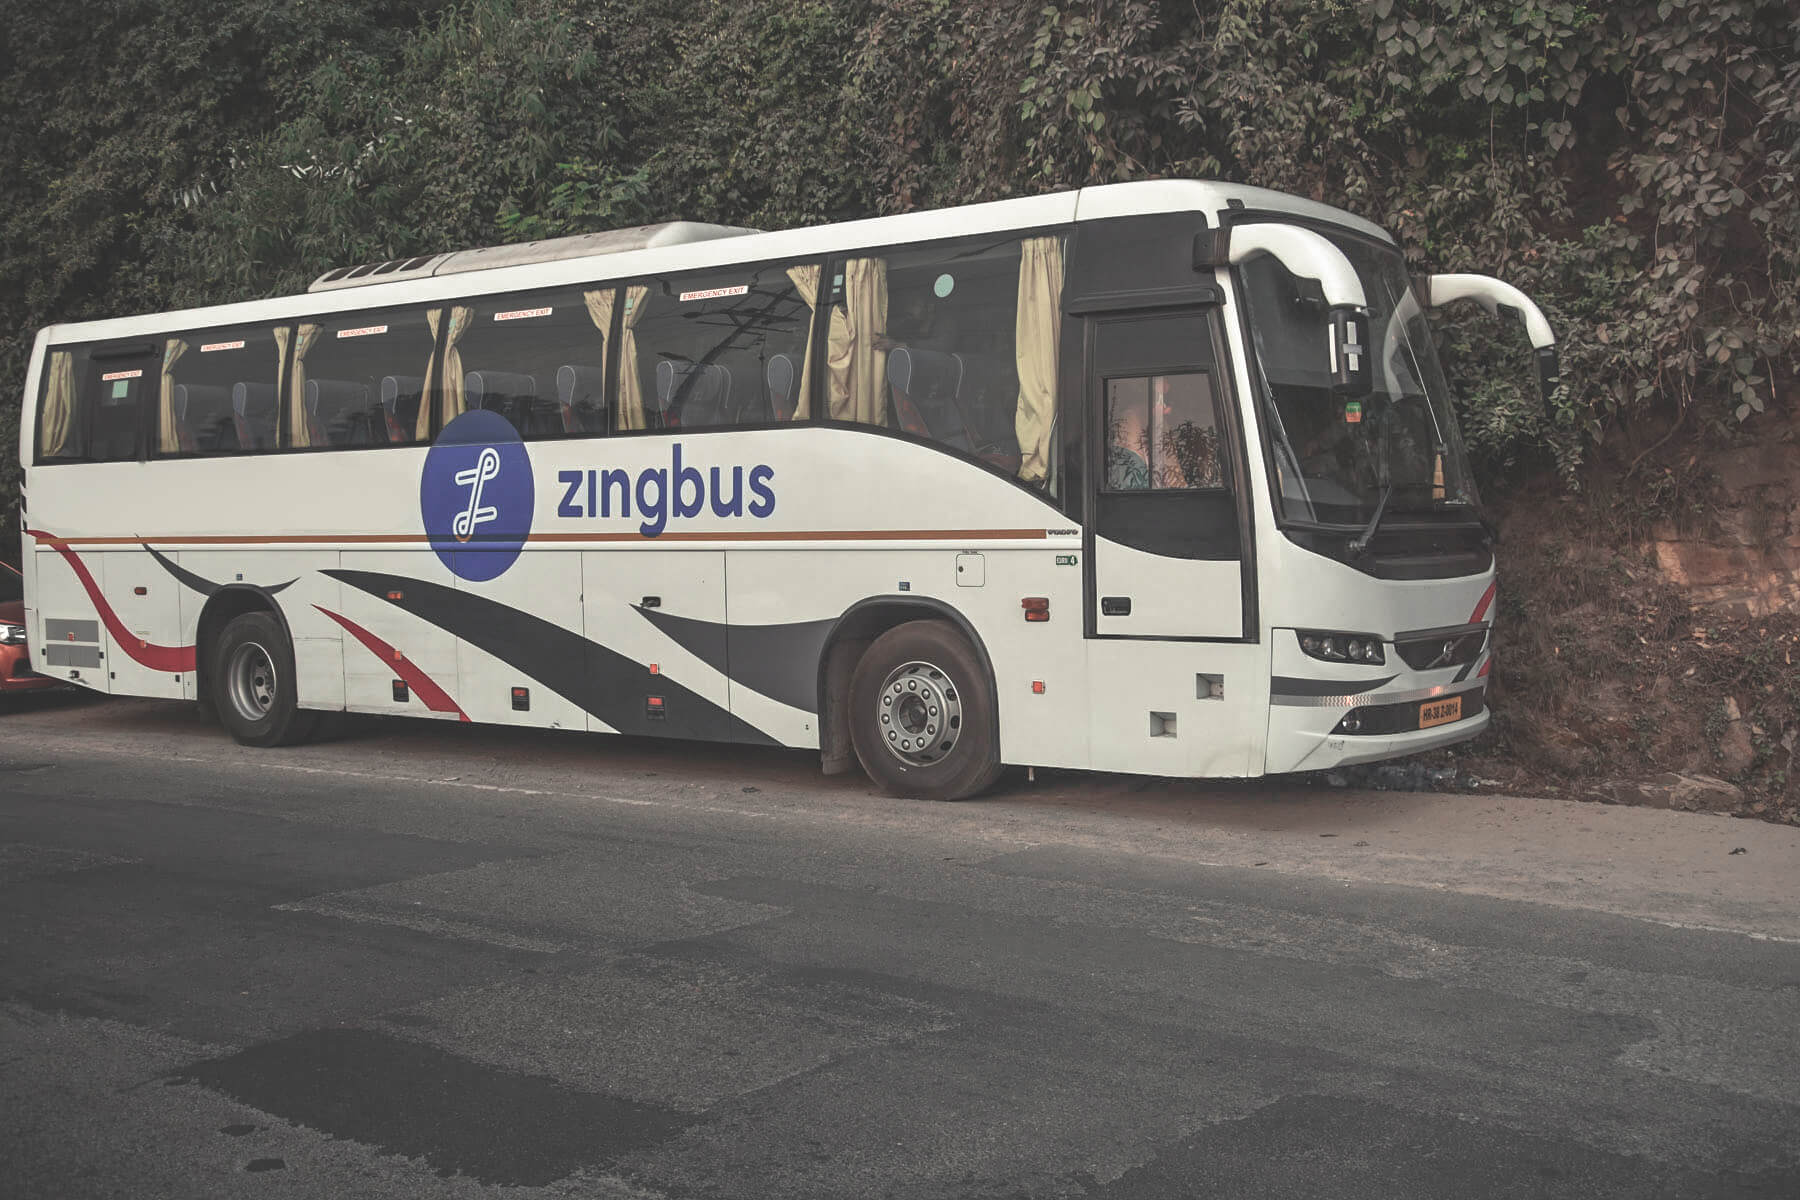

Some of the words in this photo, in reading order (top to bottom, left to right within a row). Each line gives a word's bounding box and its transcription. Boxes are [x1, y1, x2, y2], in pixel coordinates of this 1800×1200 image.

[682, 289, 727, 300] EMERGENCY
[728, 287, 745, 295] EXIT
[497, 311, 534, 320] EMERGENCY
[535, 308, 549, 316] EXIT
